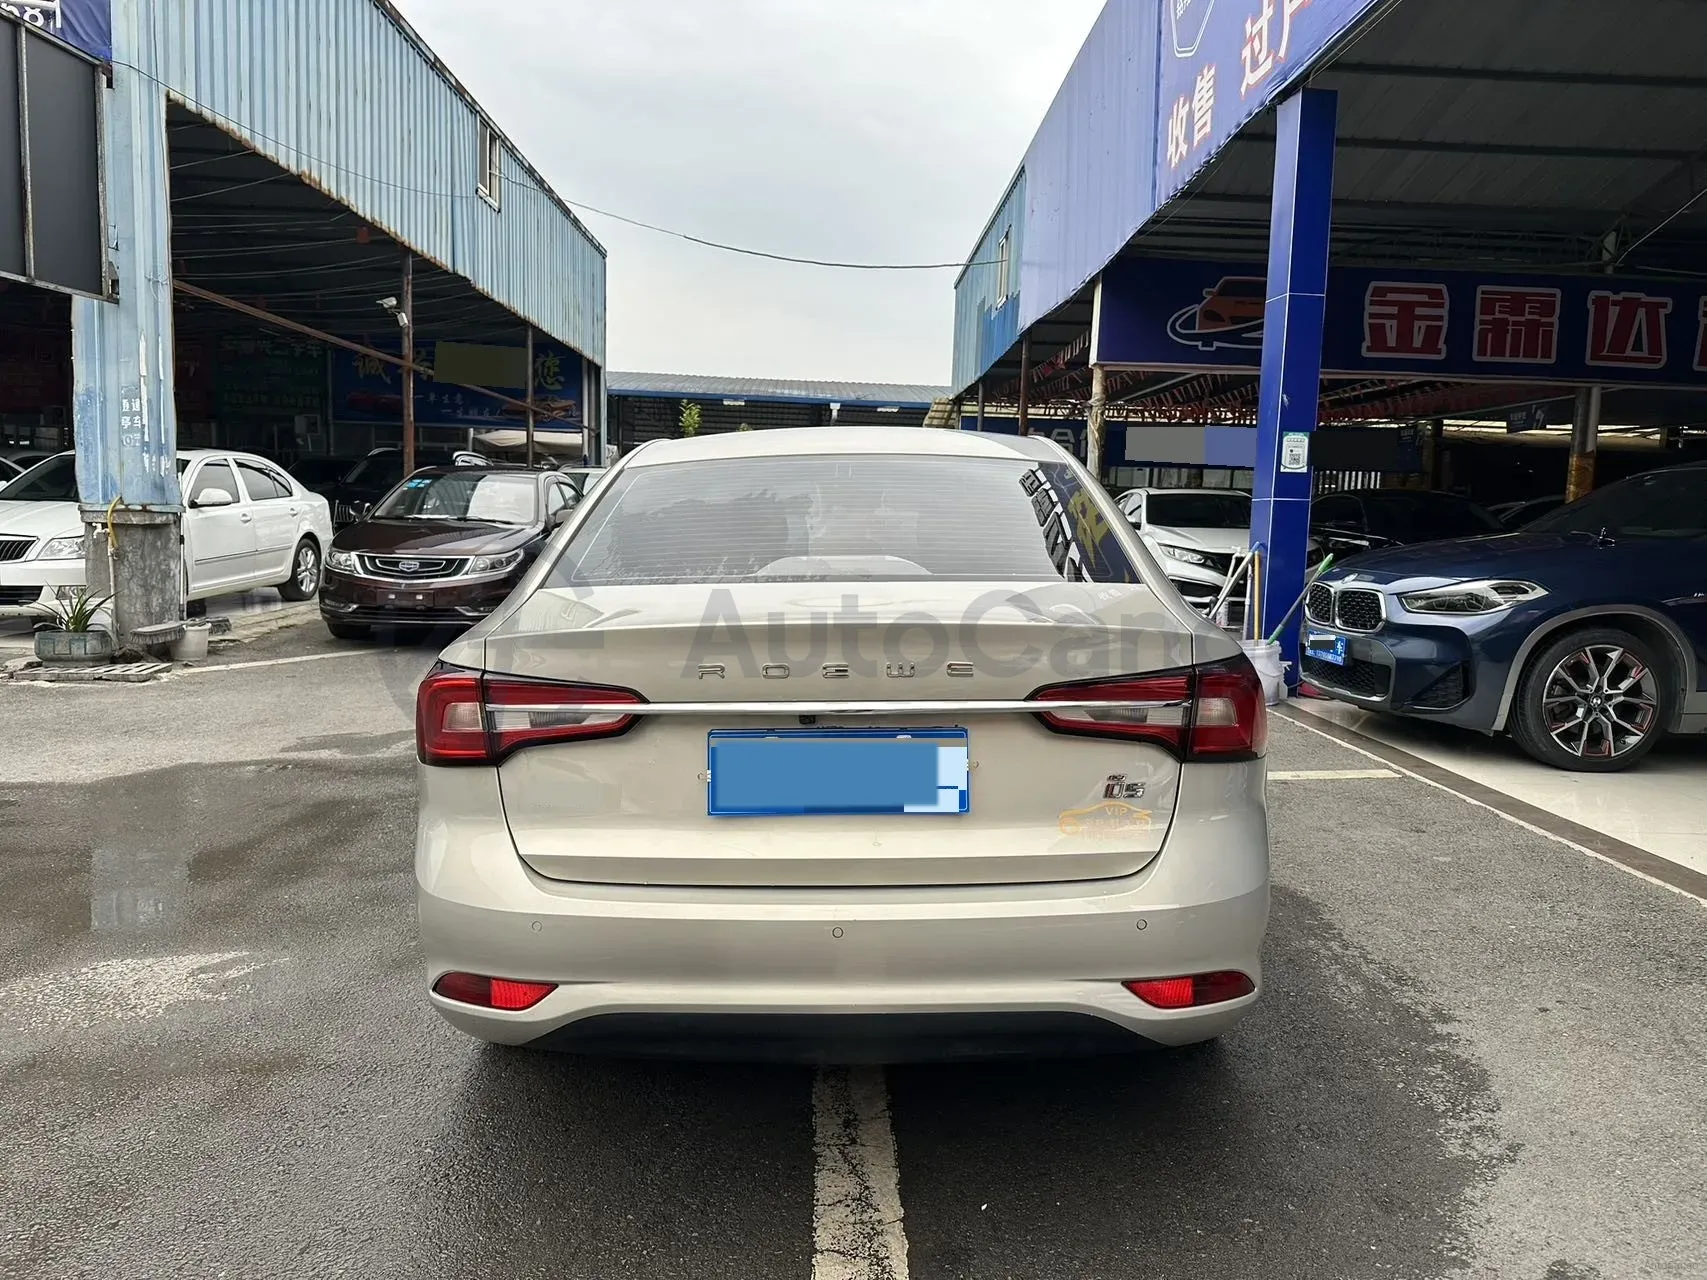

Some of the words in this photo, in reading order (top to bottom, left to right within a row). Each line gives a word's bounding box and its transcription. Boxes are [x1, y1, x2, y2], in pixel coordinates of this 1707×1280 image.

[1168, 64, 1216, 168] 收售
[1361, 280, 1707, 371] 金霖达
[1105, 806, 1128, 816] VIP
